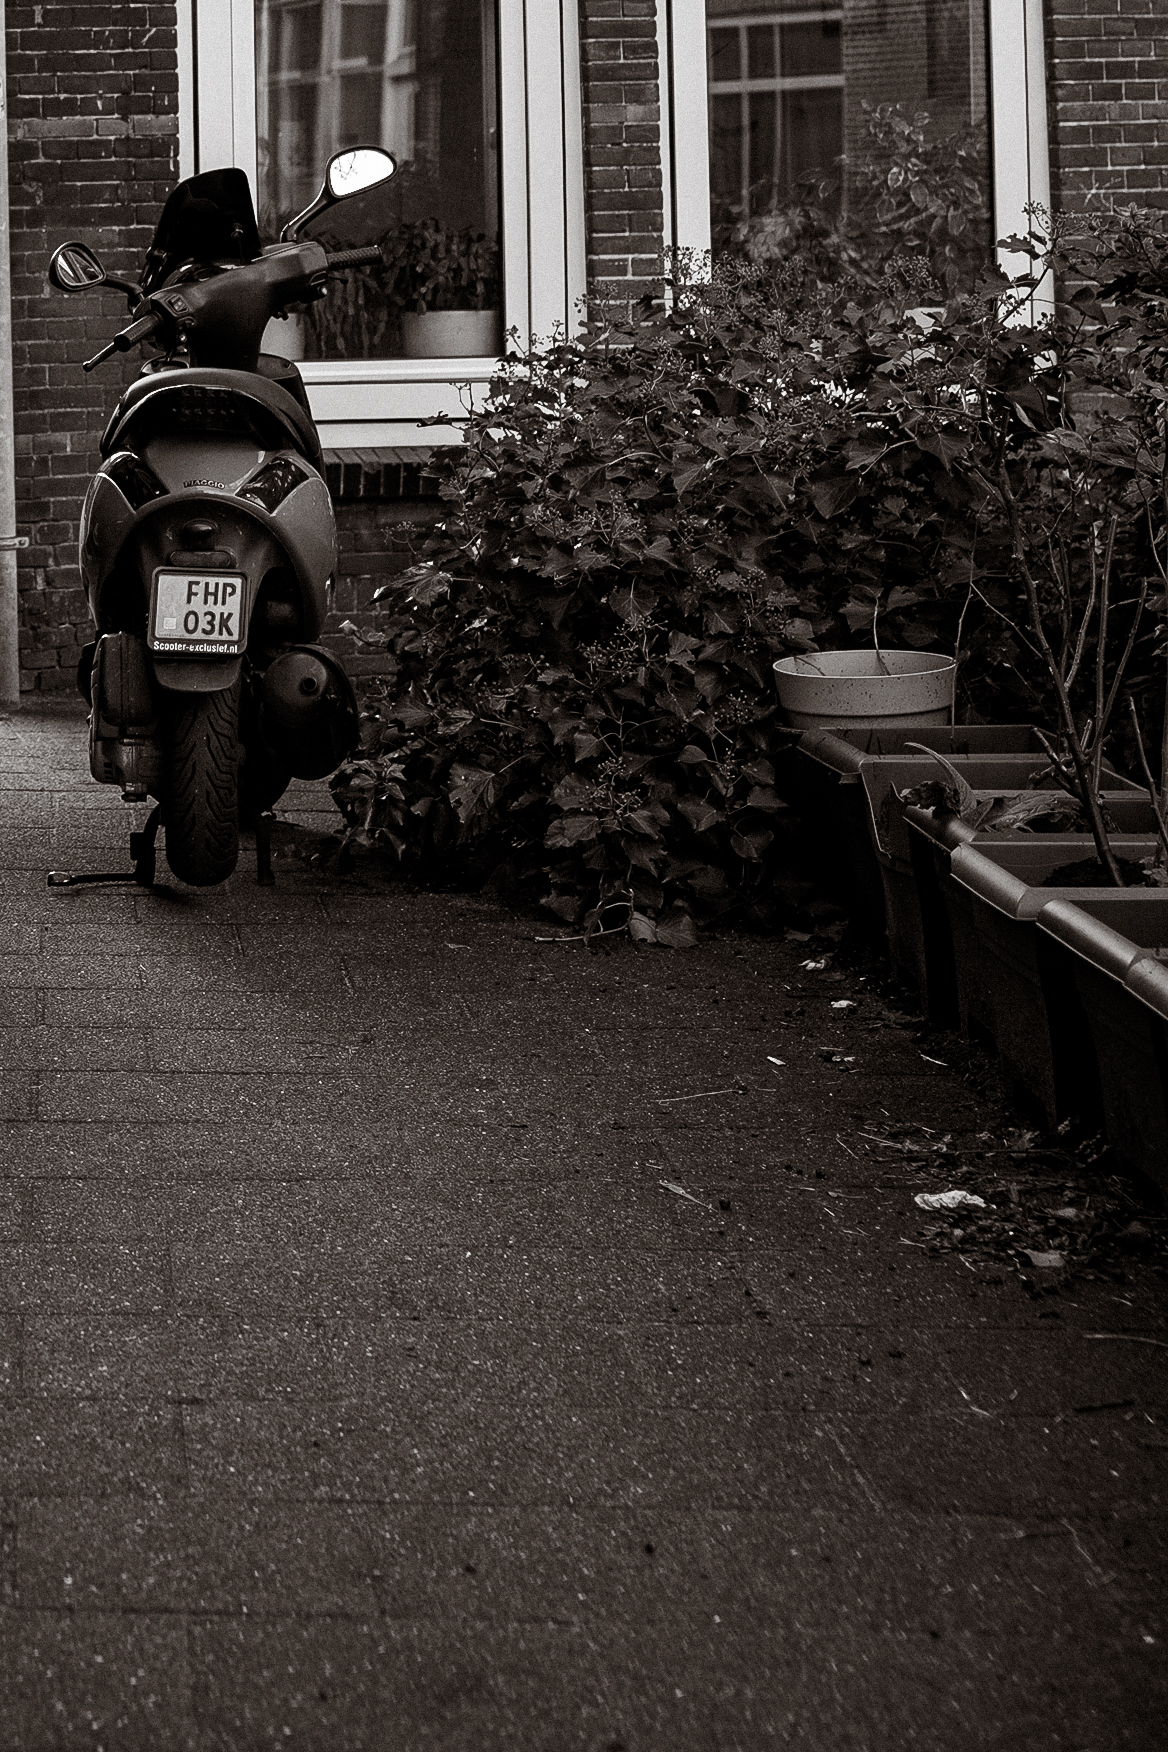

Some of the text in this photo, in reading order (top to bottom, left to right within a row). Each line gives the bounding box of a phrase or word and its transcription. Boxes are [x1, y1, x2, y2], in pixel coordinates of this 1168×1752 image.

[184, 479, 225, 489] PIAGGIO
[186, 580, 237, 606] FHP
[183, 610, 234, 637] 03K
